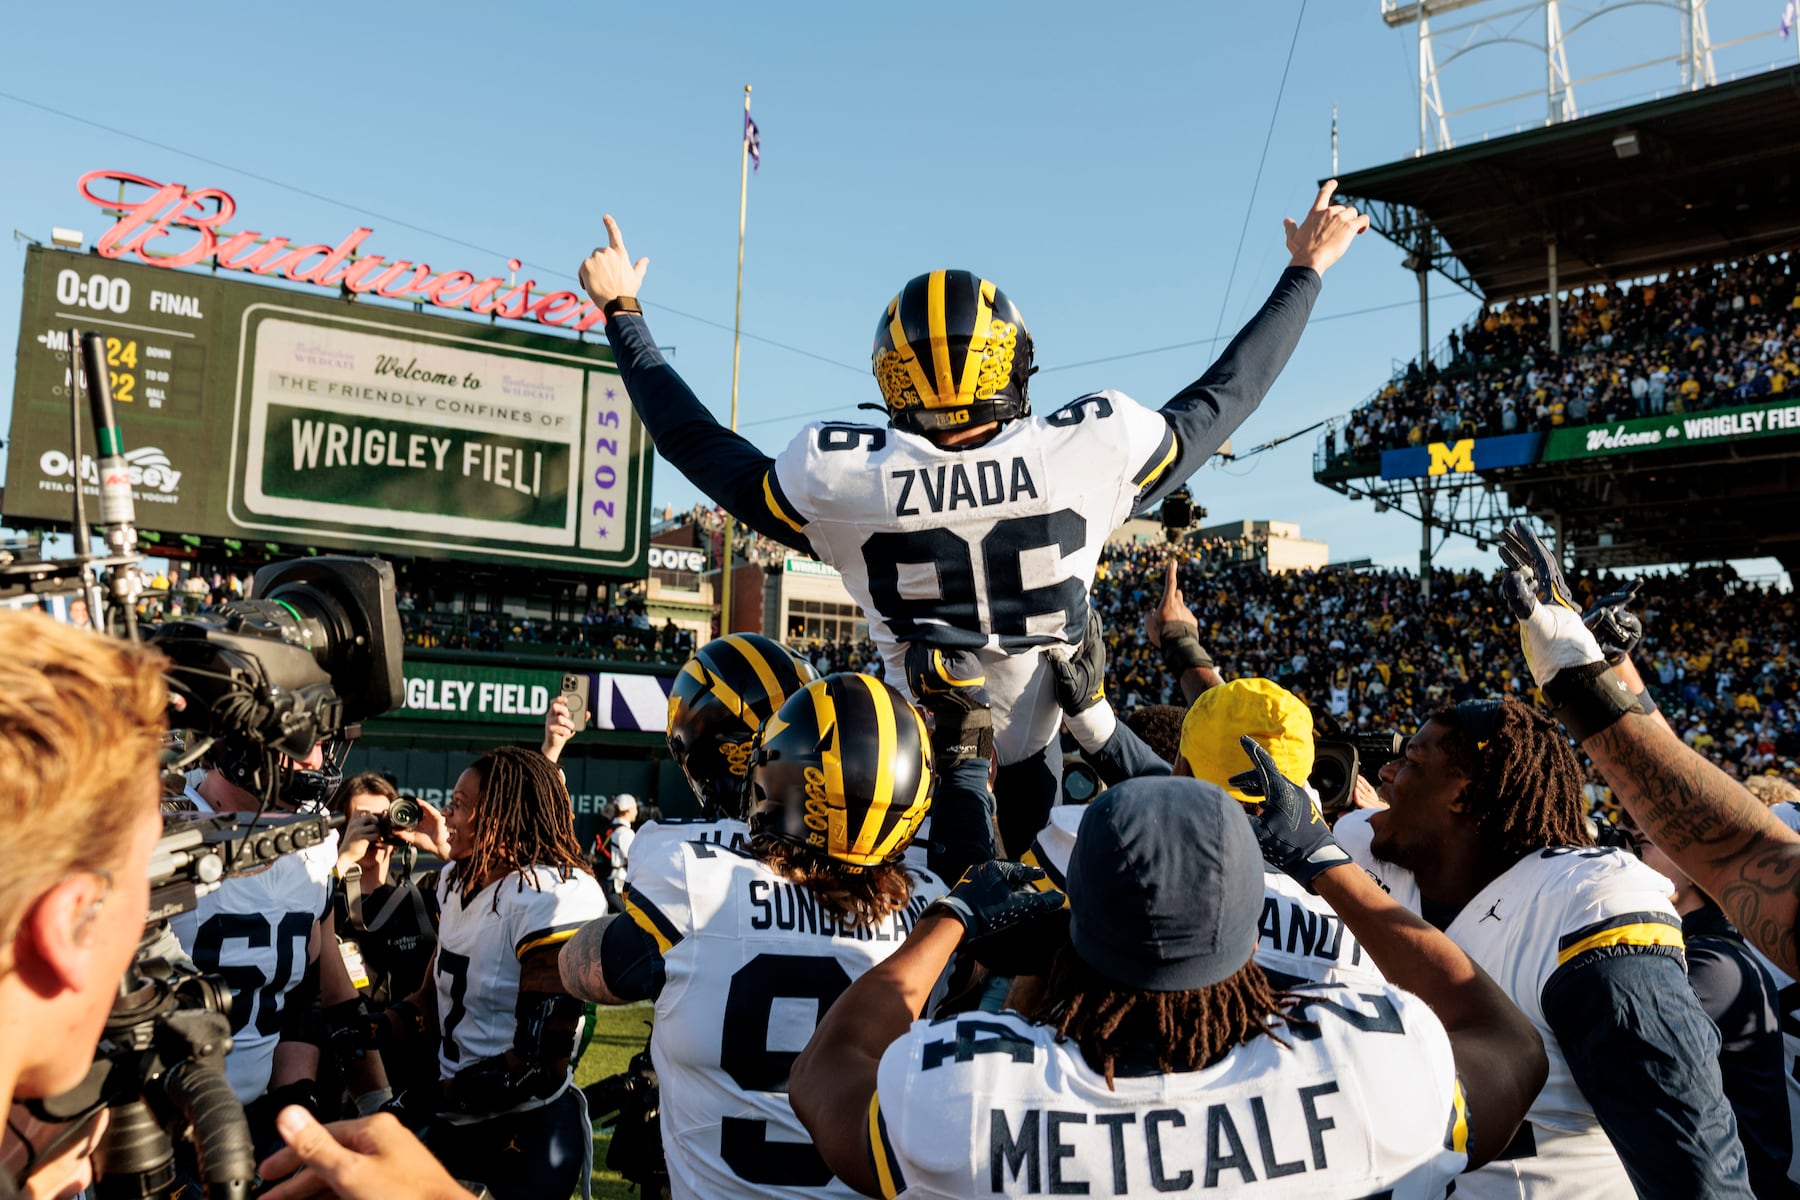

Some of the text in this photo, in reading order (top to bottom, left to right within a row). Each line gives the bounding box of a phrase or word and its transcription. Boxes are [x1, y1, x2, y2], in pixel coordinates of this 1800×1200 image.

[57, 269, 203, 319] 0:00 FINAL
[106, 337, 137, 369] 24
[146, 346, 172, 360] DOWN
[374, 354, 481, 390] Welcome to
[278, 375, 565, 427] THE FRIENDLY CONFINES OF
[292, 418, 451, 470] WRIGLEY
[1586, 424, 1662, 451] Welcome
[1683, 410, 1765, 439] WRIGLEY
[1766, 405, 1800, 431] FIE
[593, 410, 620, 518] 2025
[892, 456, 1039, 516] ZVADA
[861, 507, 1089, 656] 96
[478, 681, 548, 716] FIELD
[989, 1080, 1341, 1196] METCALF
